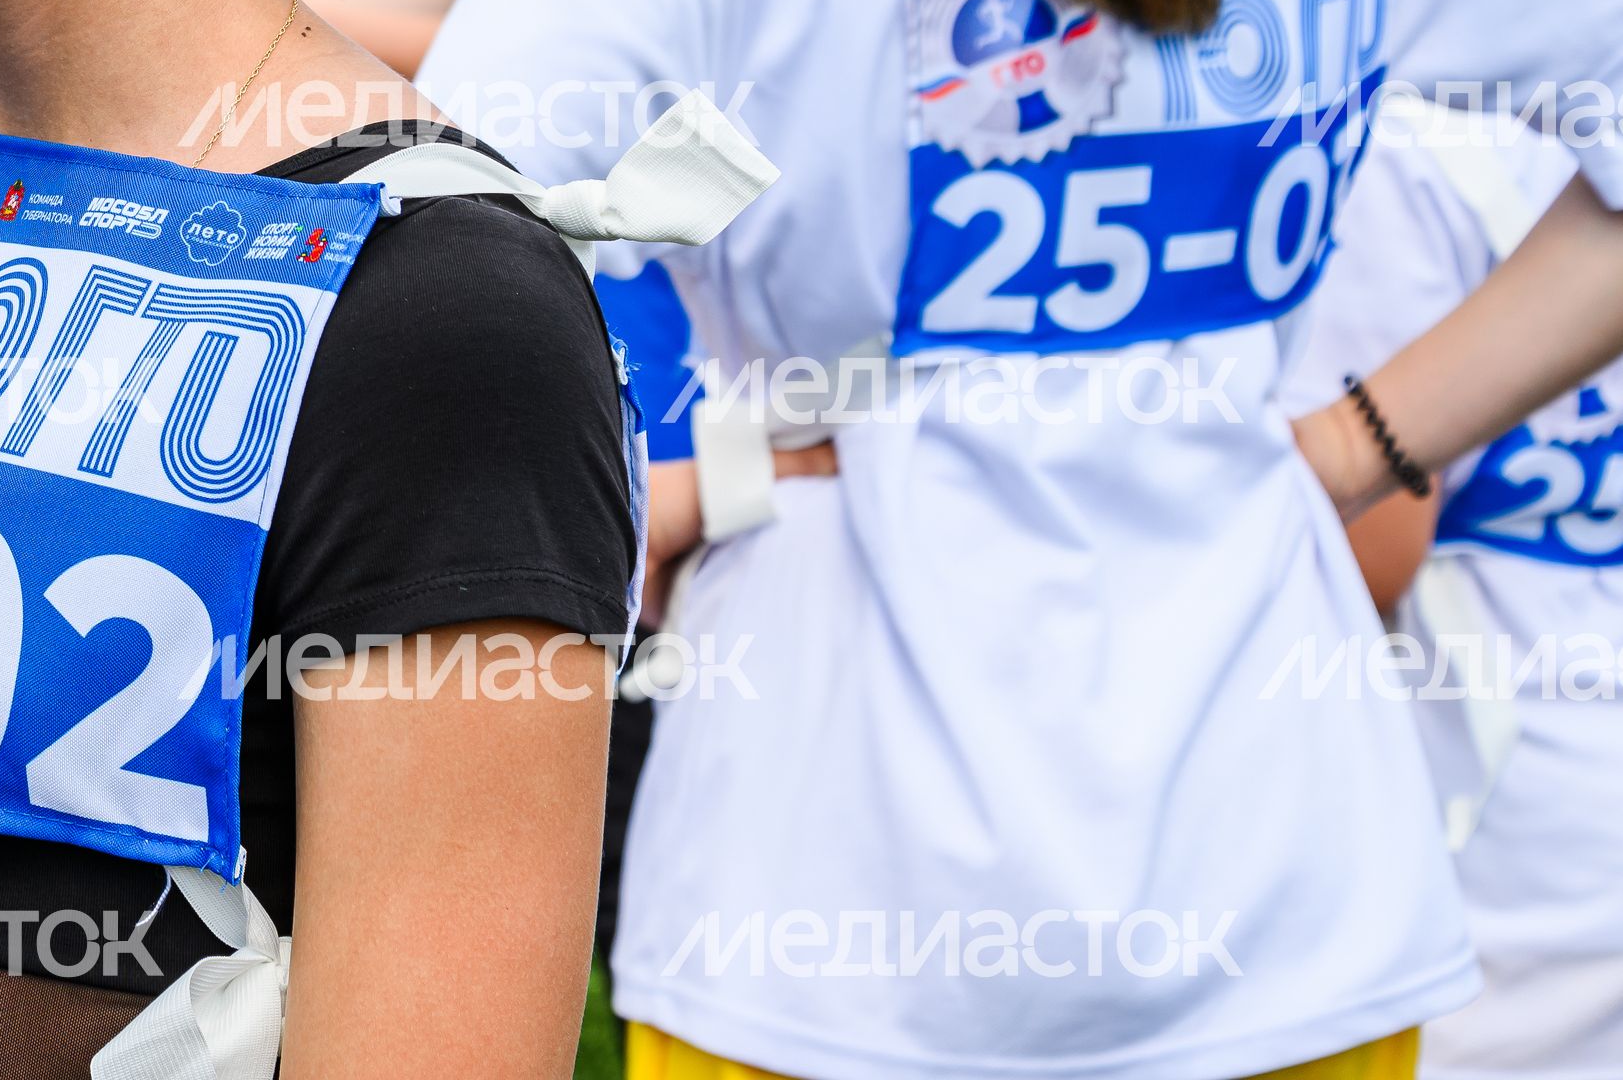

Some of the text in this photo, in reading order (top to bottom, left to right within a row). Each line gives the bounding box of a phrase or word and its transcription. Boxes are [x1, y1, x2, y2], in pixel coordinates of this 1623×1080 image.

[29, 193, 64, 208] КОМАНДА
[22, 209, 74, 226] ГУБЕРНАТОРА
[87, 196, 170, 225] МОСОБЛ
[79, 212, 143, 235] СПОРТ
[261, 222, 299, 236] СПОРТ
[187, 222, 240, 245] лето
[252, 235, 298, 248] НОРМА
[243, 247, 289, 260] ЖИЗНИ
